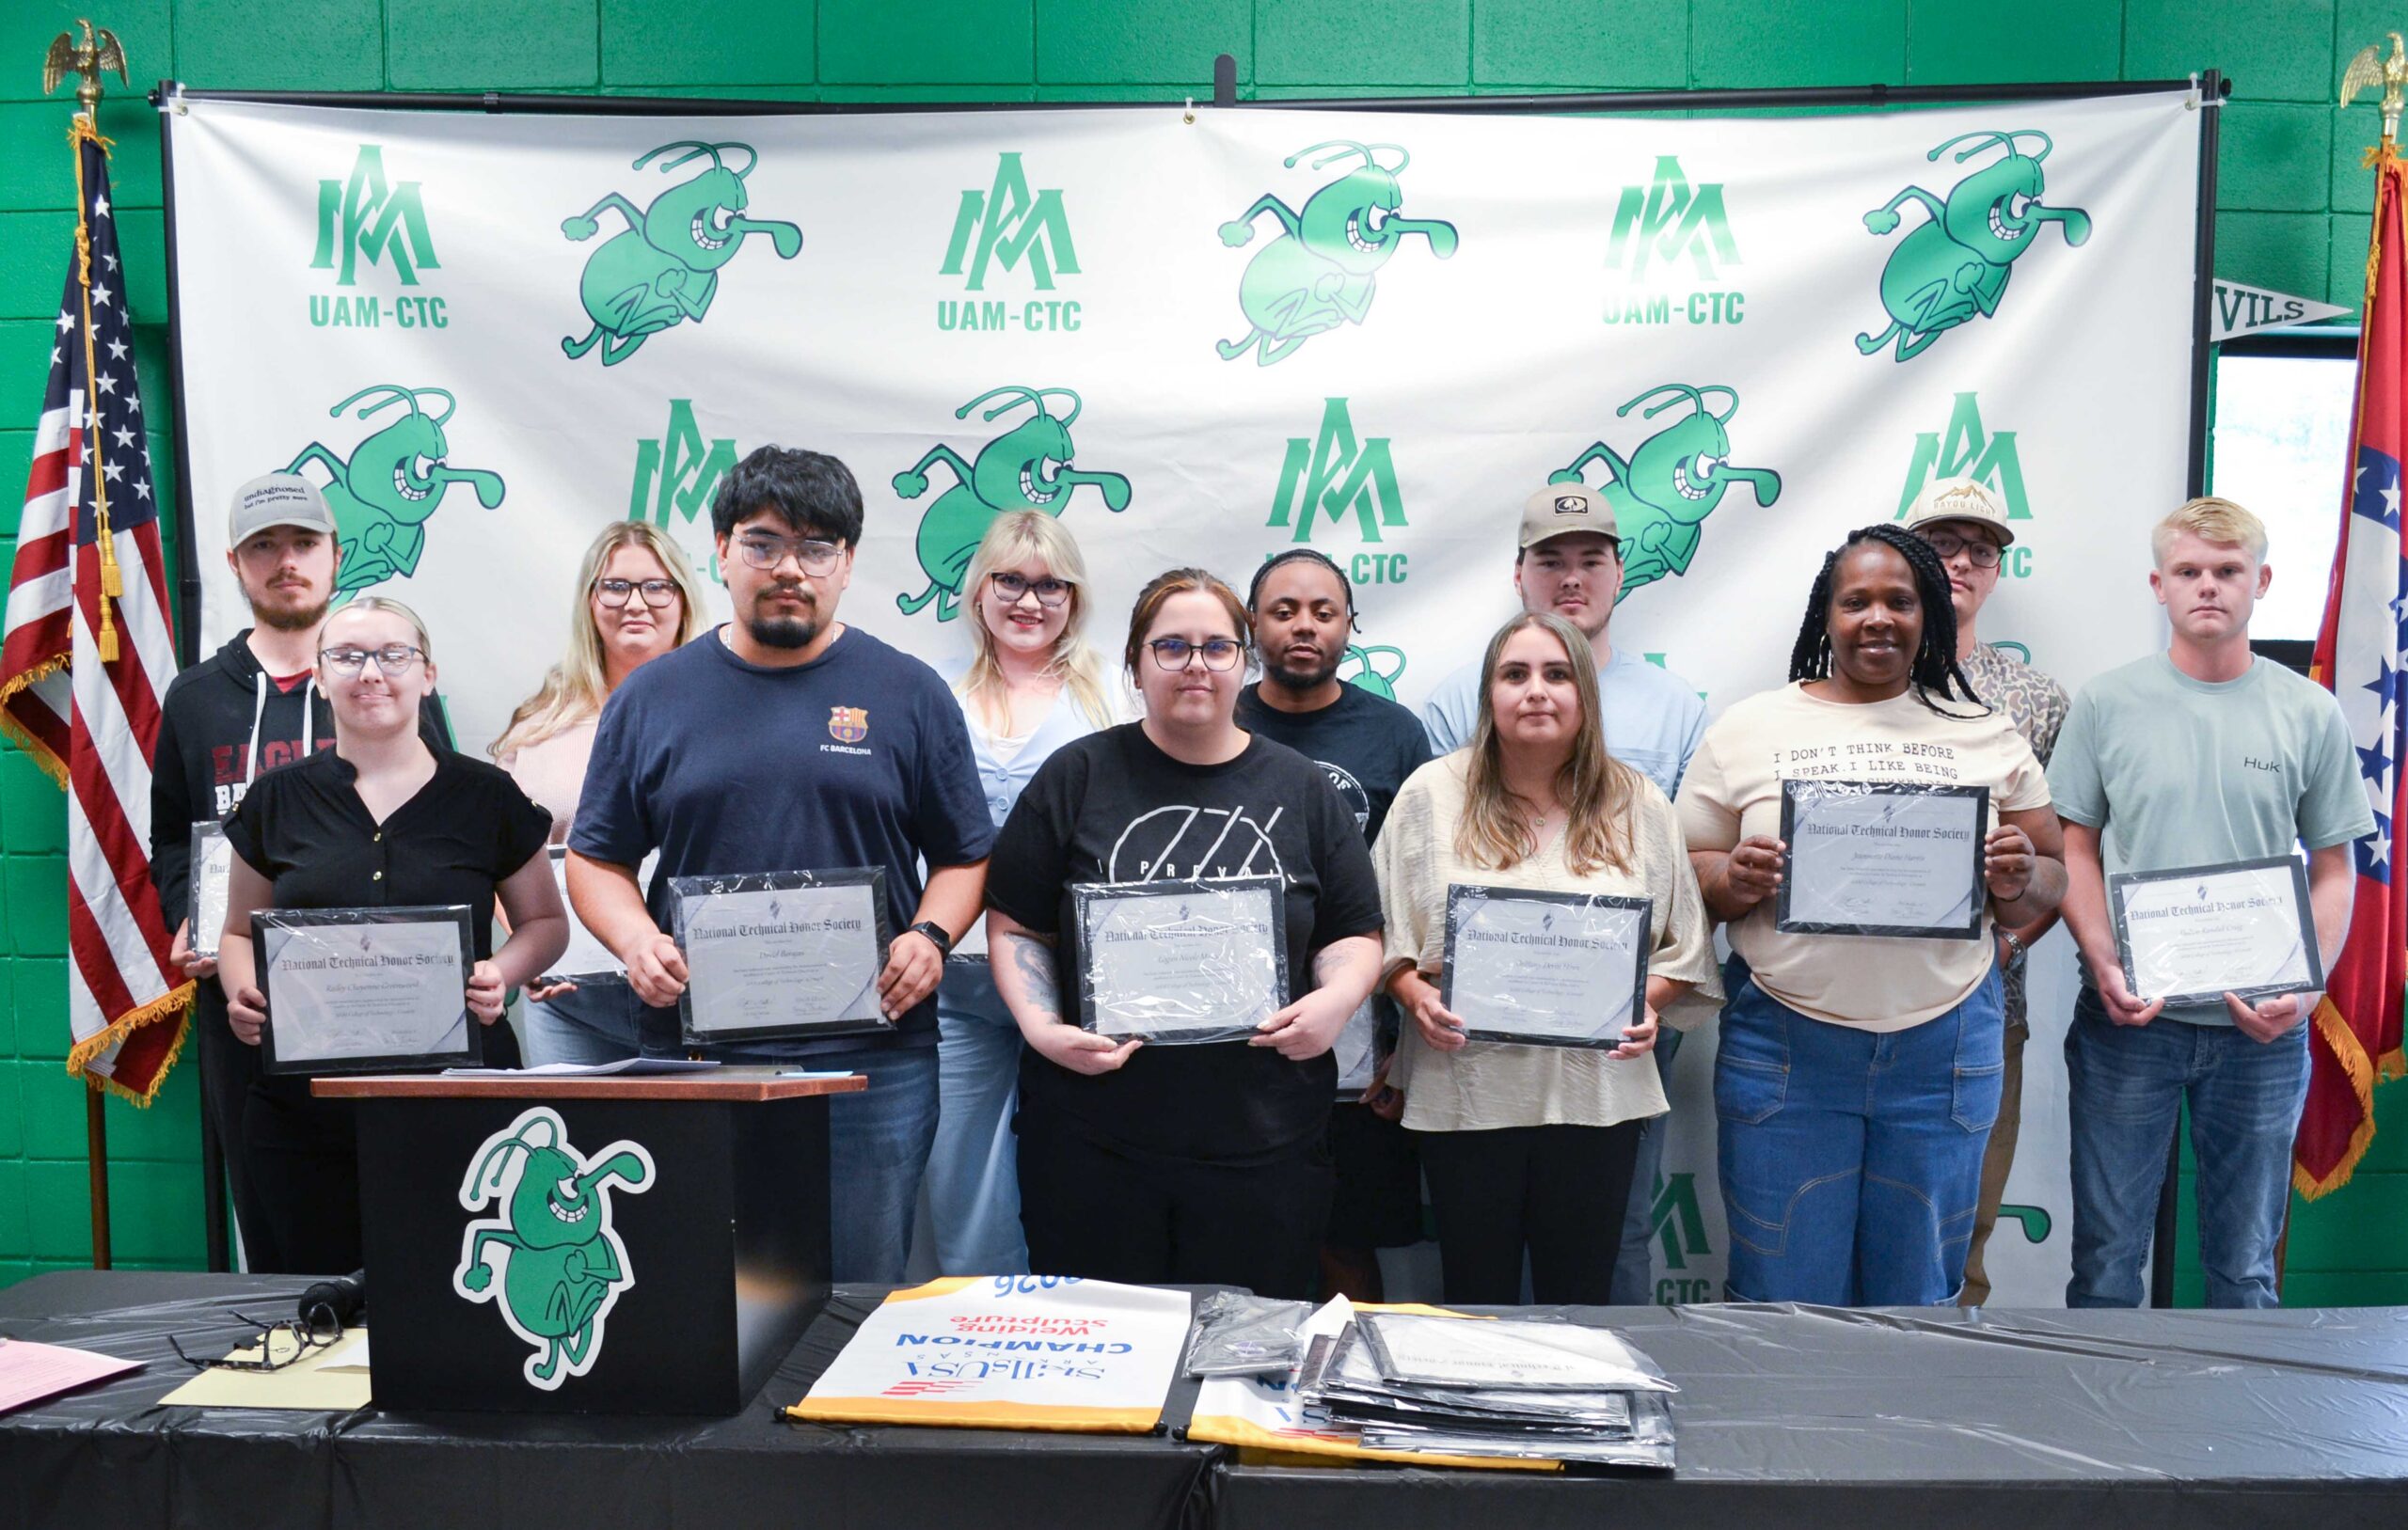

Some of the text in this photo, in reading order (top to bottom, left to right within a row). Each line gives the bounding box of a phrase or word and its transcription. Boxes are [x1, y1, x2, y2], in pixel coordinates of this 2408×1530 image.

[309, 294, 448, 329] UAM-CTC
[938, 301, 1082, 332] UAM-CTC
[1602, 292, 1745, 325] UAM-CTC
[819, 744, 872, 755] FC BARCELONA
[1790, 746, 1836, 762] DON'T
[1846, 742, 1894, 755] THINK
[1902, 742, 1955, 760] BEFORE
[1869, 761, 1906, 771] LIKE
[1916, 762, 1958, 780] BEING
[1807, 823, 1971, 842] National Technical Honor Society
[2131, 908, 2168, 921] National
[2171, 905, 2214, 918] Technical
[693, 918, 862, 939] National Technical Honor Society
[1467, 929, 1508, 943] National
[1511, 932, 1556, 947] Technical
[1559, 935, 1591, 950] Honor
[281, 957, 326, 971] National
[329, 954, 378, 970] Technical
[380, 954, 412, 967] Honor
[950, 1315, 1109, 1328] Sculpture
[954, 1323, 1090, 1336] Welding
[895, 1333, 1133, 1354] CHAMPION
